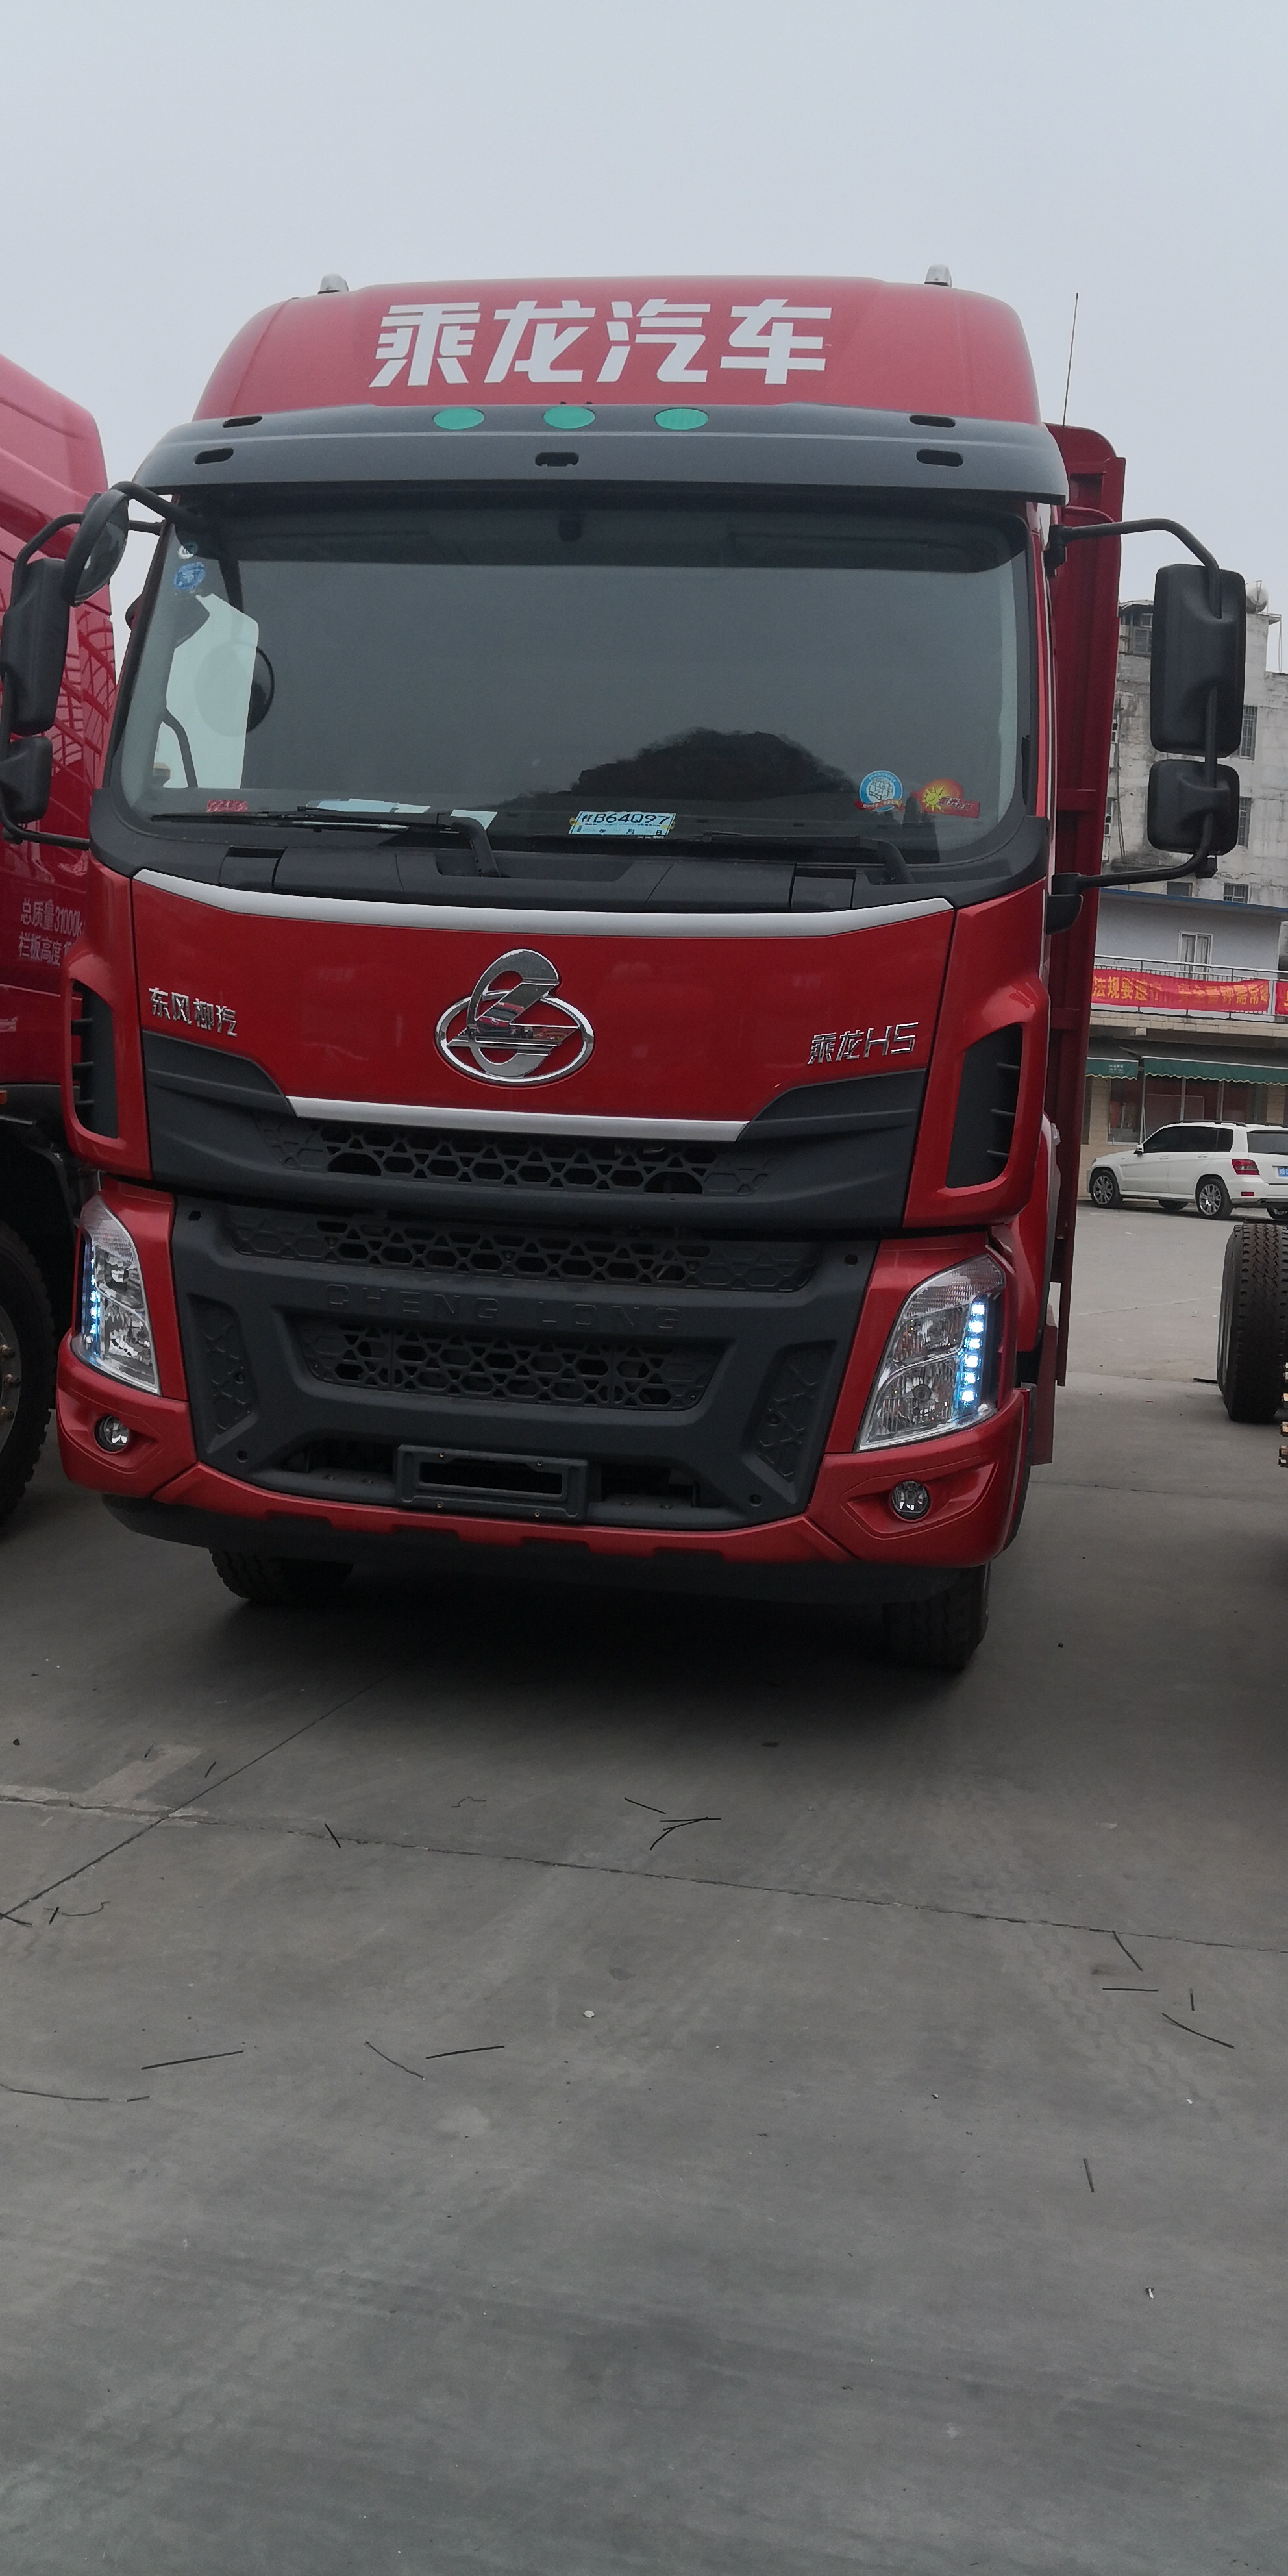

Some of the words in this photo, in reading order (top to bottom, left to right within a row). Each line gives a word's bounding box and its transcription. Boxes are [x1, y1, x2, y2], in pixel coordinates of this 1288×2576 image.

[369, 298, 832, 388] 乘龙汽车
[20, 897, 85, 939] 总质量31000k
[148, 987, 238, 1038] 东风柳汽
[325, 1283, 499, 1320] CHENG
[536, 1300, 680, 1331] LONG
